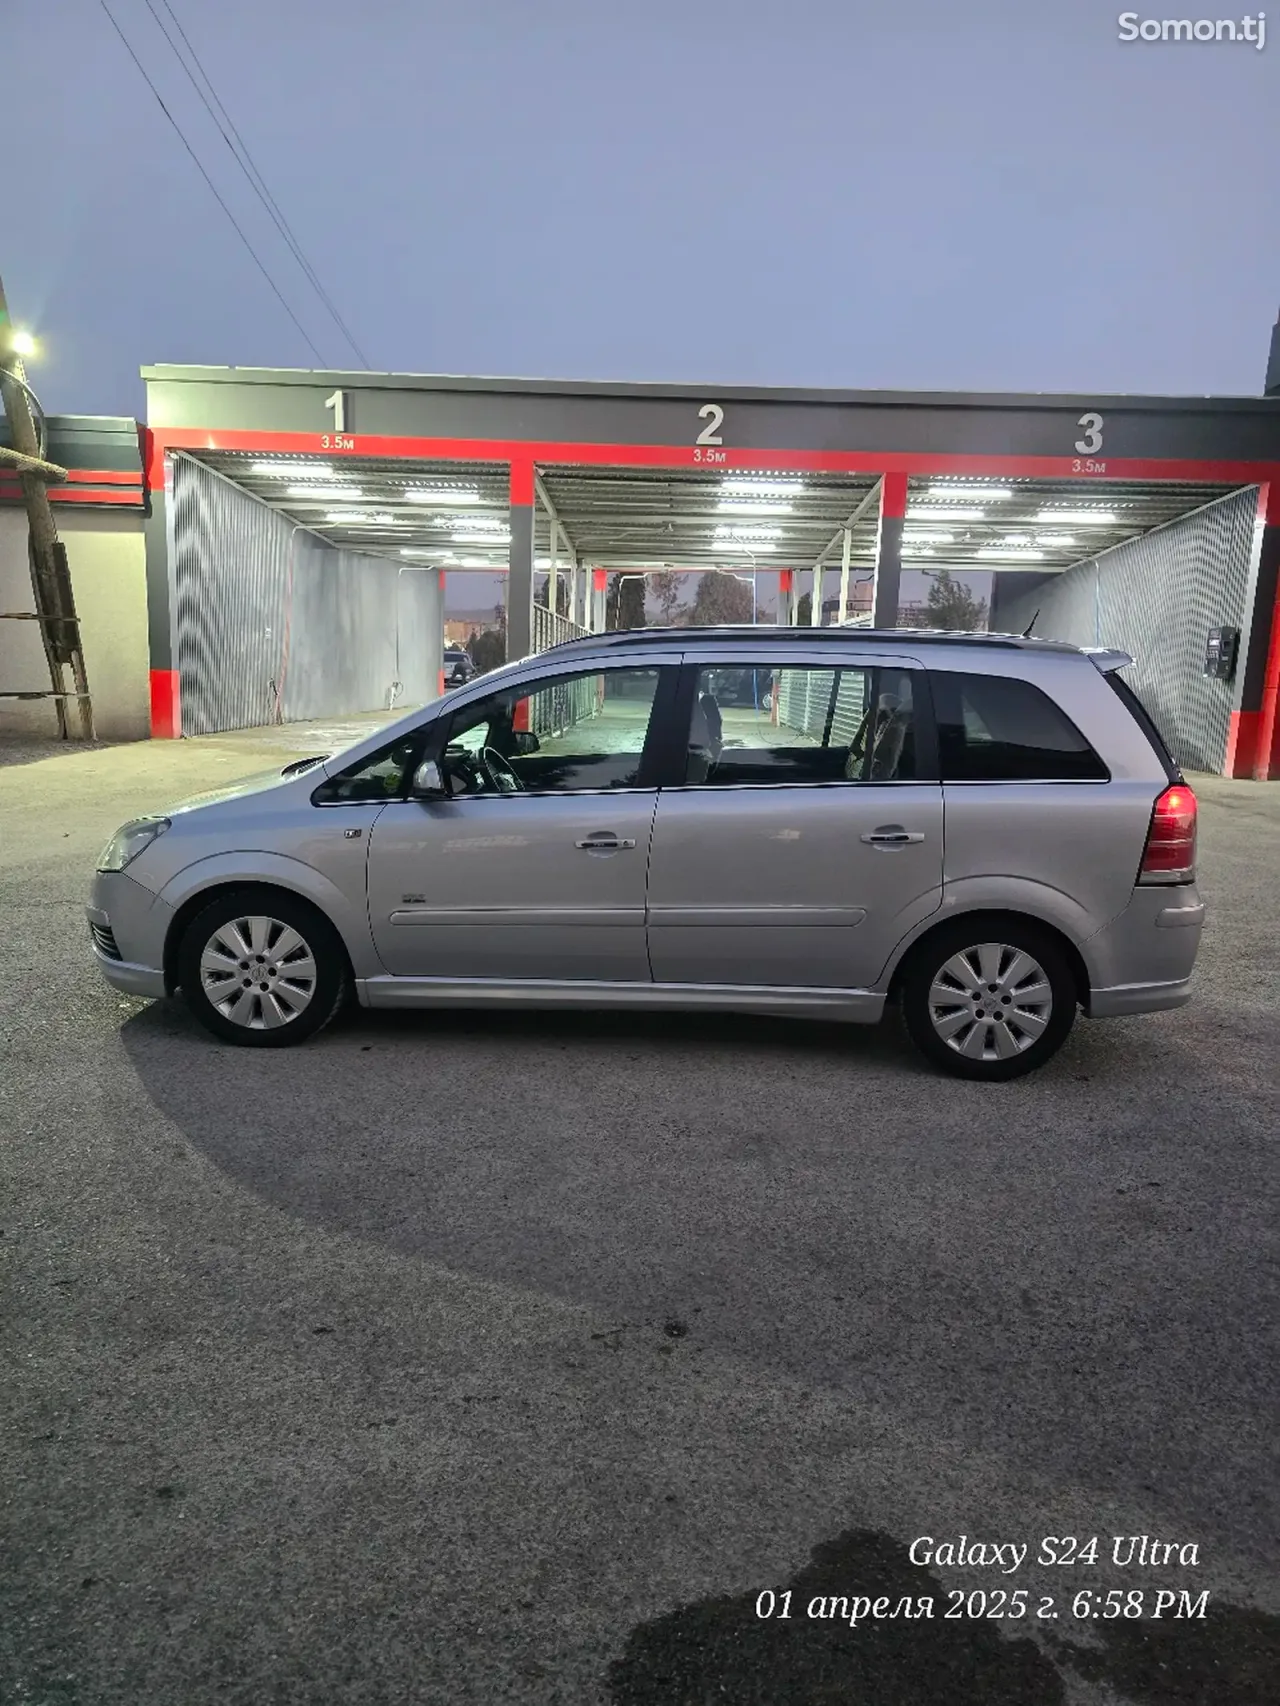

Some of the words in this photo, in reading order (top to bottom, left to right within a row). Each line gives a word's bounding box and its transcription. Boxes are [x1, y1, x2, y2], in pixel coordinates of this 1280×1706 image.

[325, 390, 345, 431] 1
[696, 404, 724, 445] 2
[1075, 412, 1104, 455] 3
